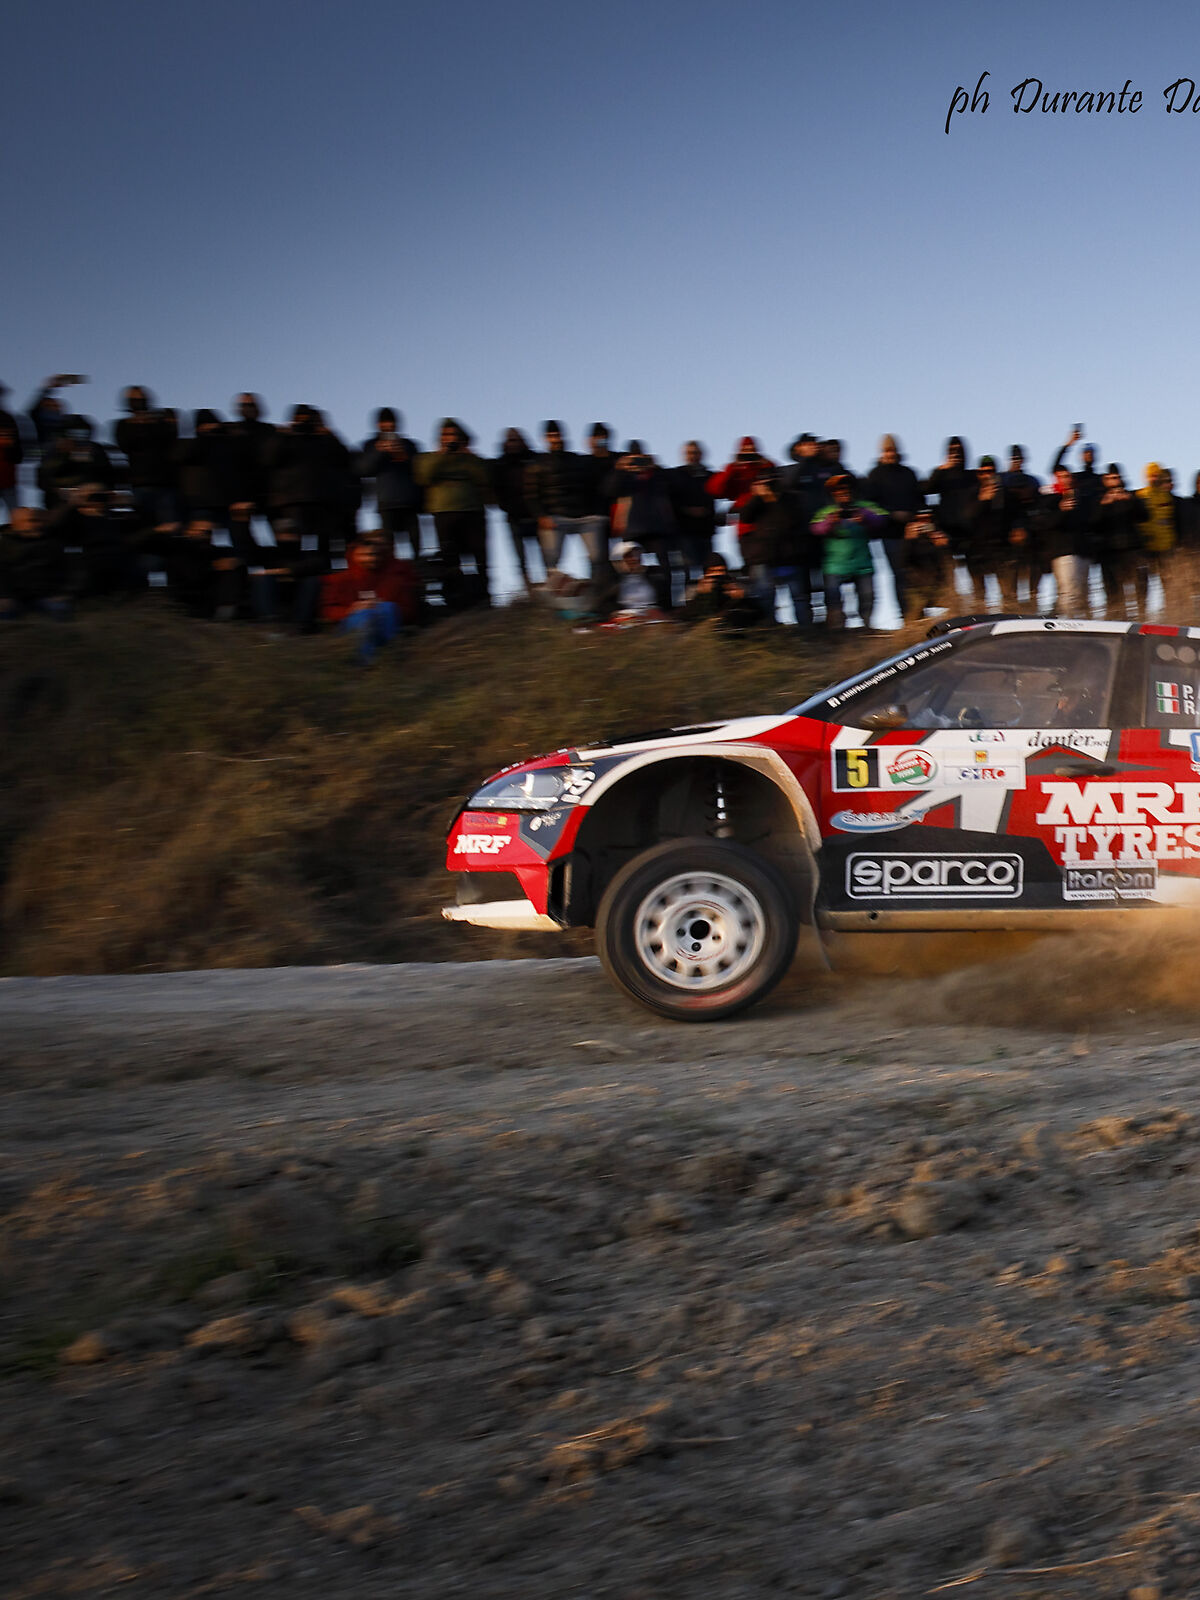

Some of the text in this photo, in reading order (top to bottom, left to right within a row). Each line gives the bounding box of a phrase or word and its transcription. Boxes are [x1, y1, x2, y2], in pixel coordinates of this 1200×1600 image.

[1181, 684, 1195, 700] P.
[1183, 699, 1199, 716] R.
[846, 749, 869, 788] 5
[453, 834, 512, 854] MRF
[853, 860, 1015, 895] sparco
